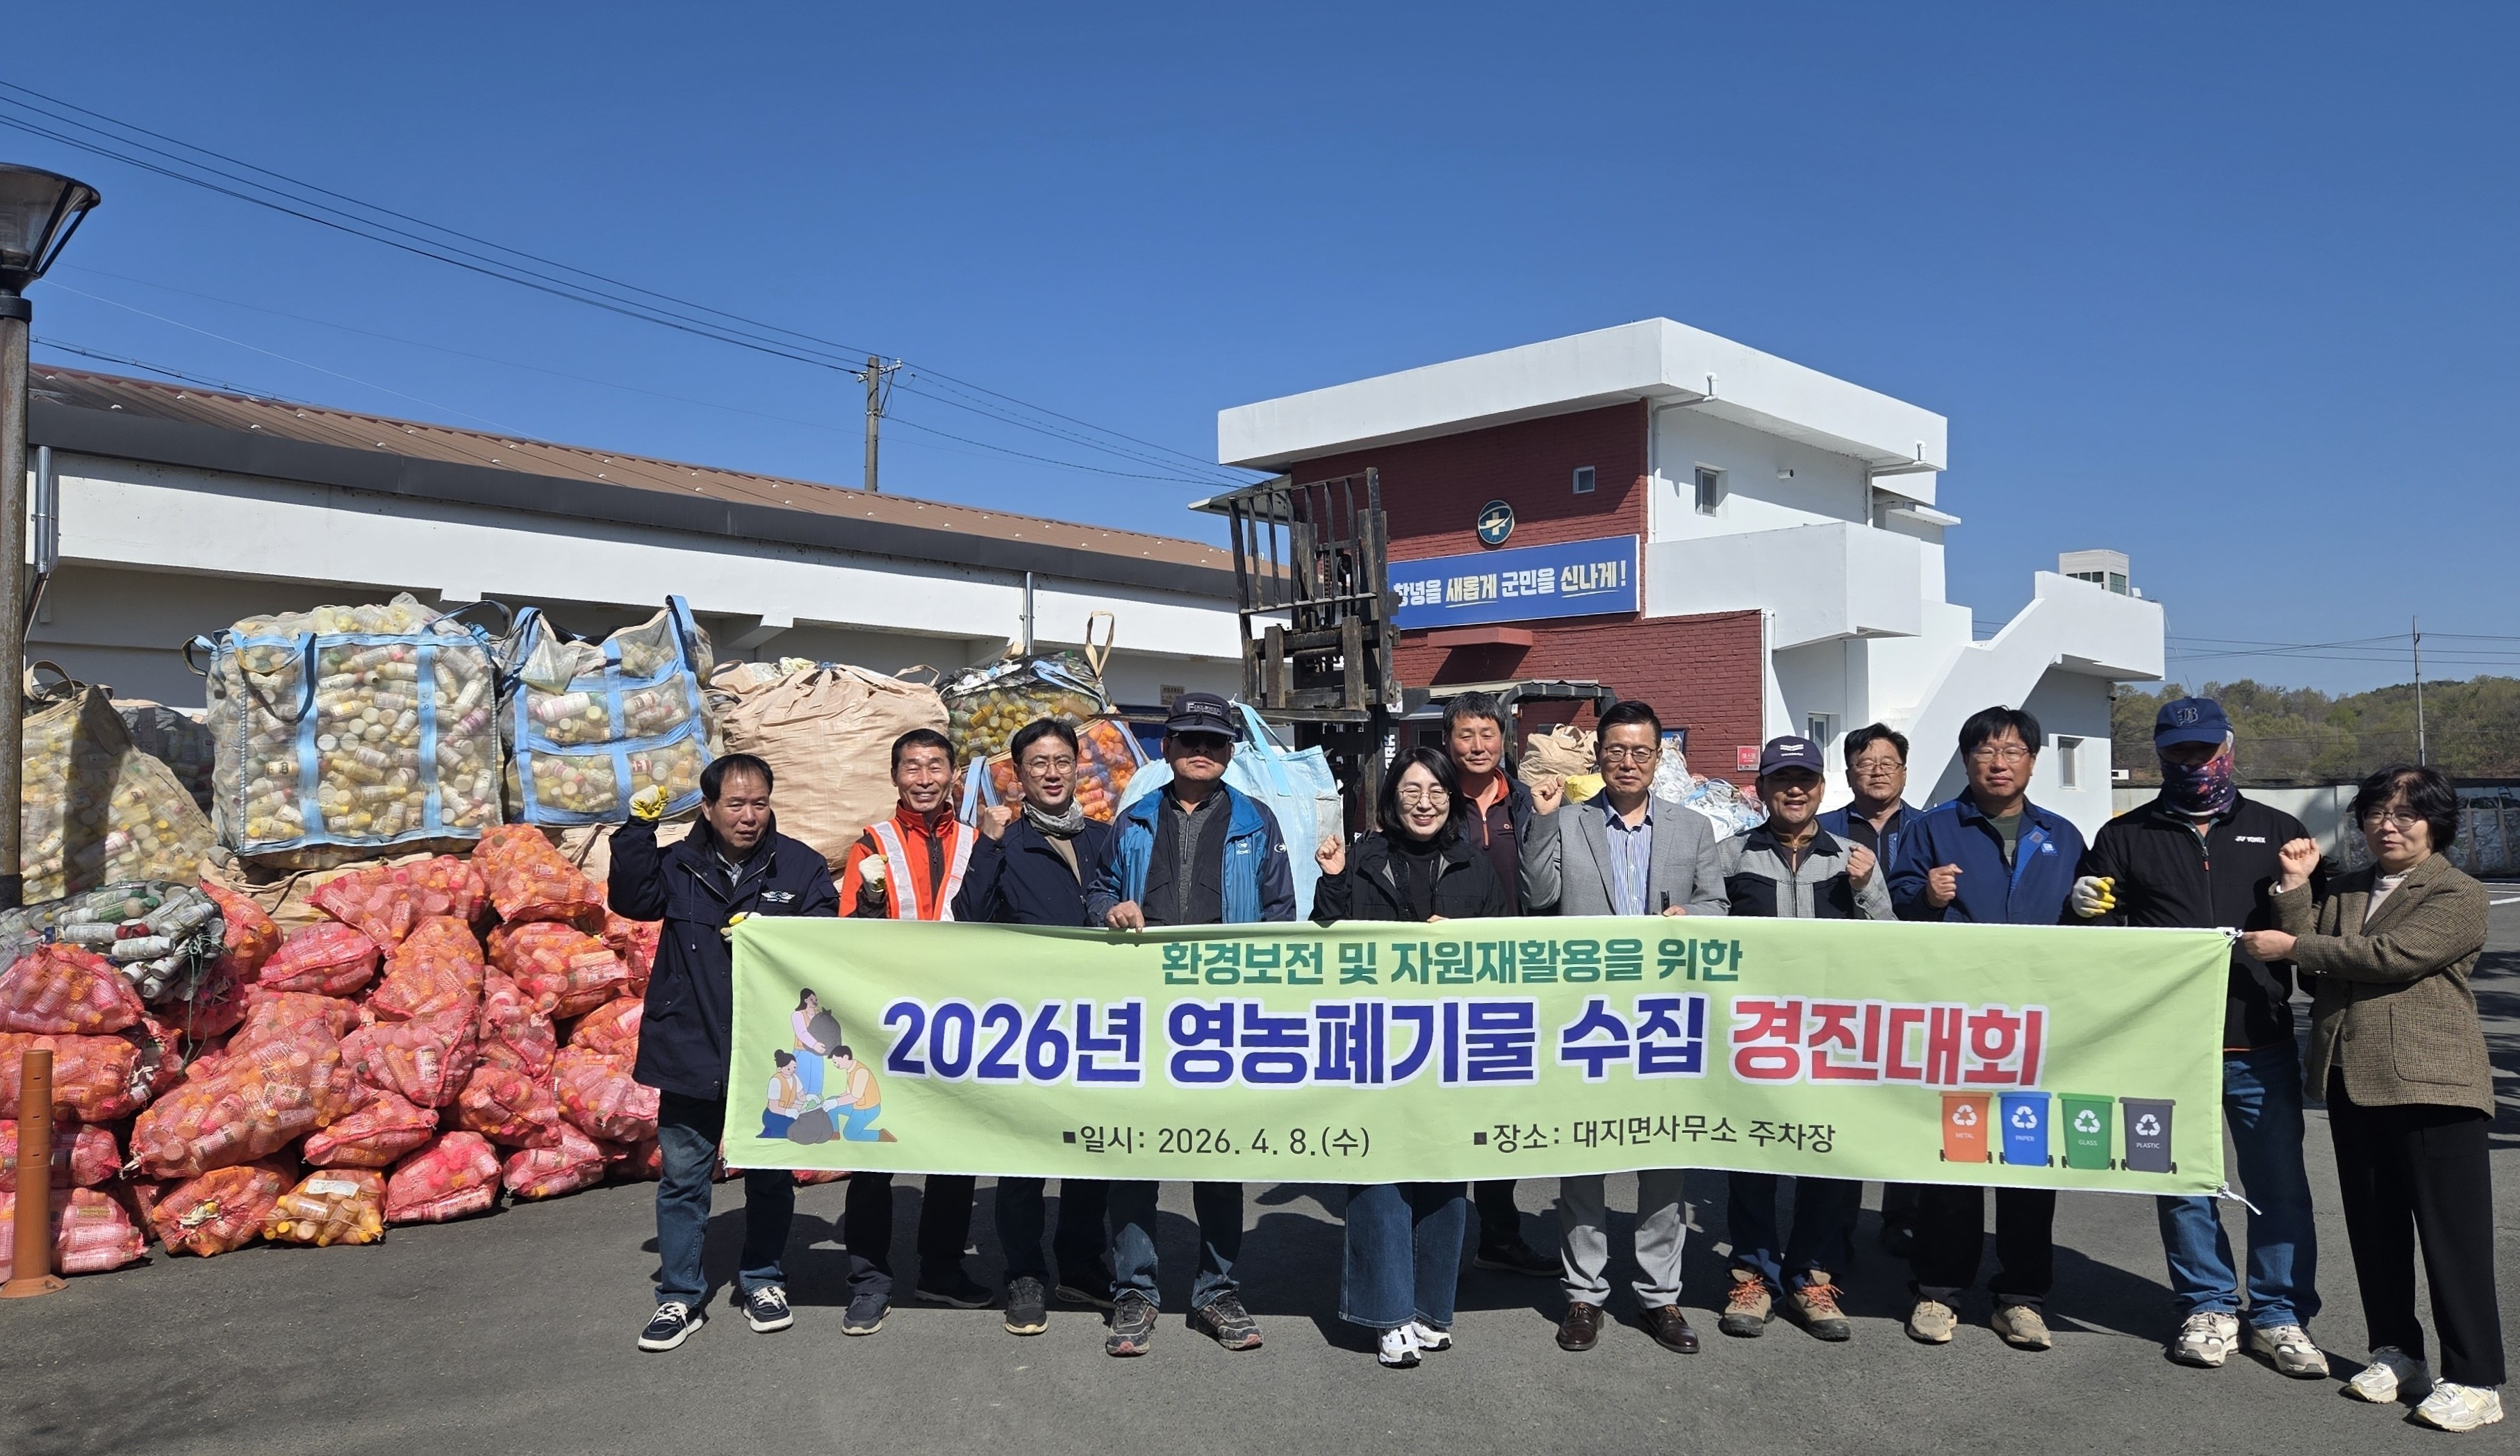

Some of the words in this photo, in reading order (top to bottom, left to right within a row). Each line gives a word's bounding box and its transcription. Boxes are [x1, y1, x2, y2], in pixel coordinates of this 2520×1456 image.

[1393, 579, 1442, 607] 창녕을
[1445, 573, 1498, 602] 새롭게
[1501, 567, 1556, 597] 군민을
[2246, 836, 2266, 844] YONEX
[1162, 941, 1324, 985] 환경보전
[1338, 941, 1378, 985] 및
[1391, 938, 1644, 985] 자원재활용을
[1657, 938, 1743, 982] 위한
[883, 1000, 1142, 1082] 2026년
[1168, 1000, 1537, 1084] 영농폐기물
[1562, 997, 1704, 1079] 수집
[1731, 1000, 2041, 1087] 경진대회
[1158, 1127, 1240, 1155] 2026.
[1251, 1128, 1278, 1155] 4.
[1573, 1115, 1738, 1148] 대지면사무소
[1748, 1120, 1836, 1153] 주차장
[2136, 1141, 2161, 1150] PLASTIC
